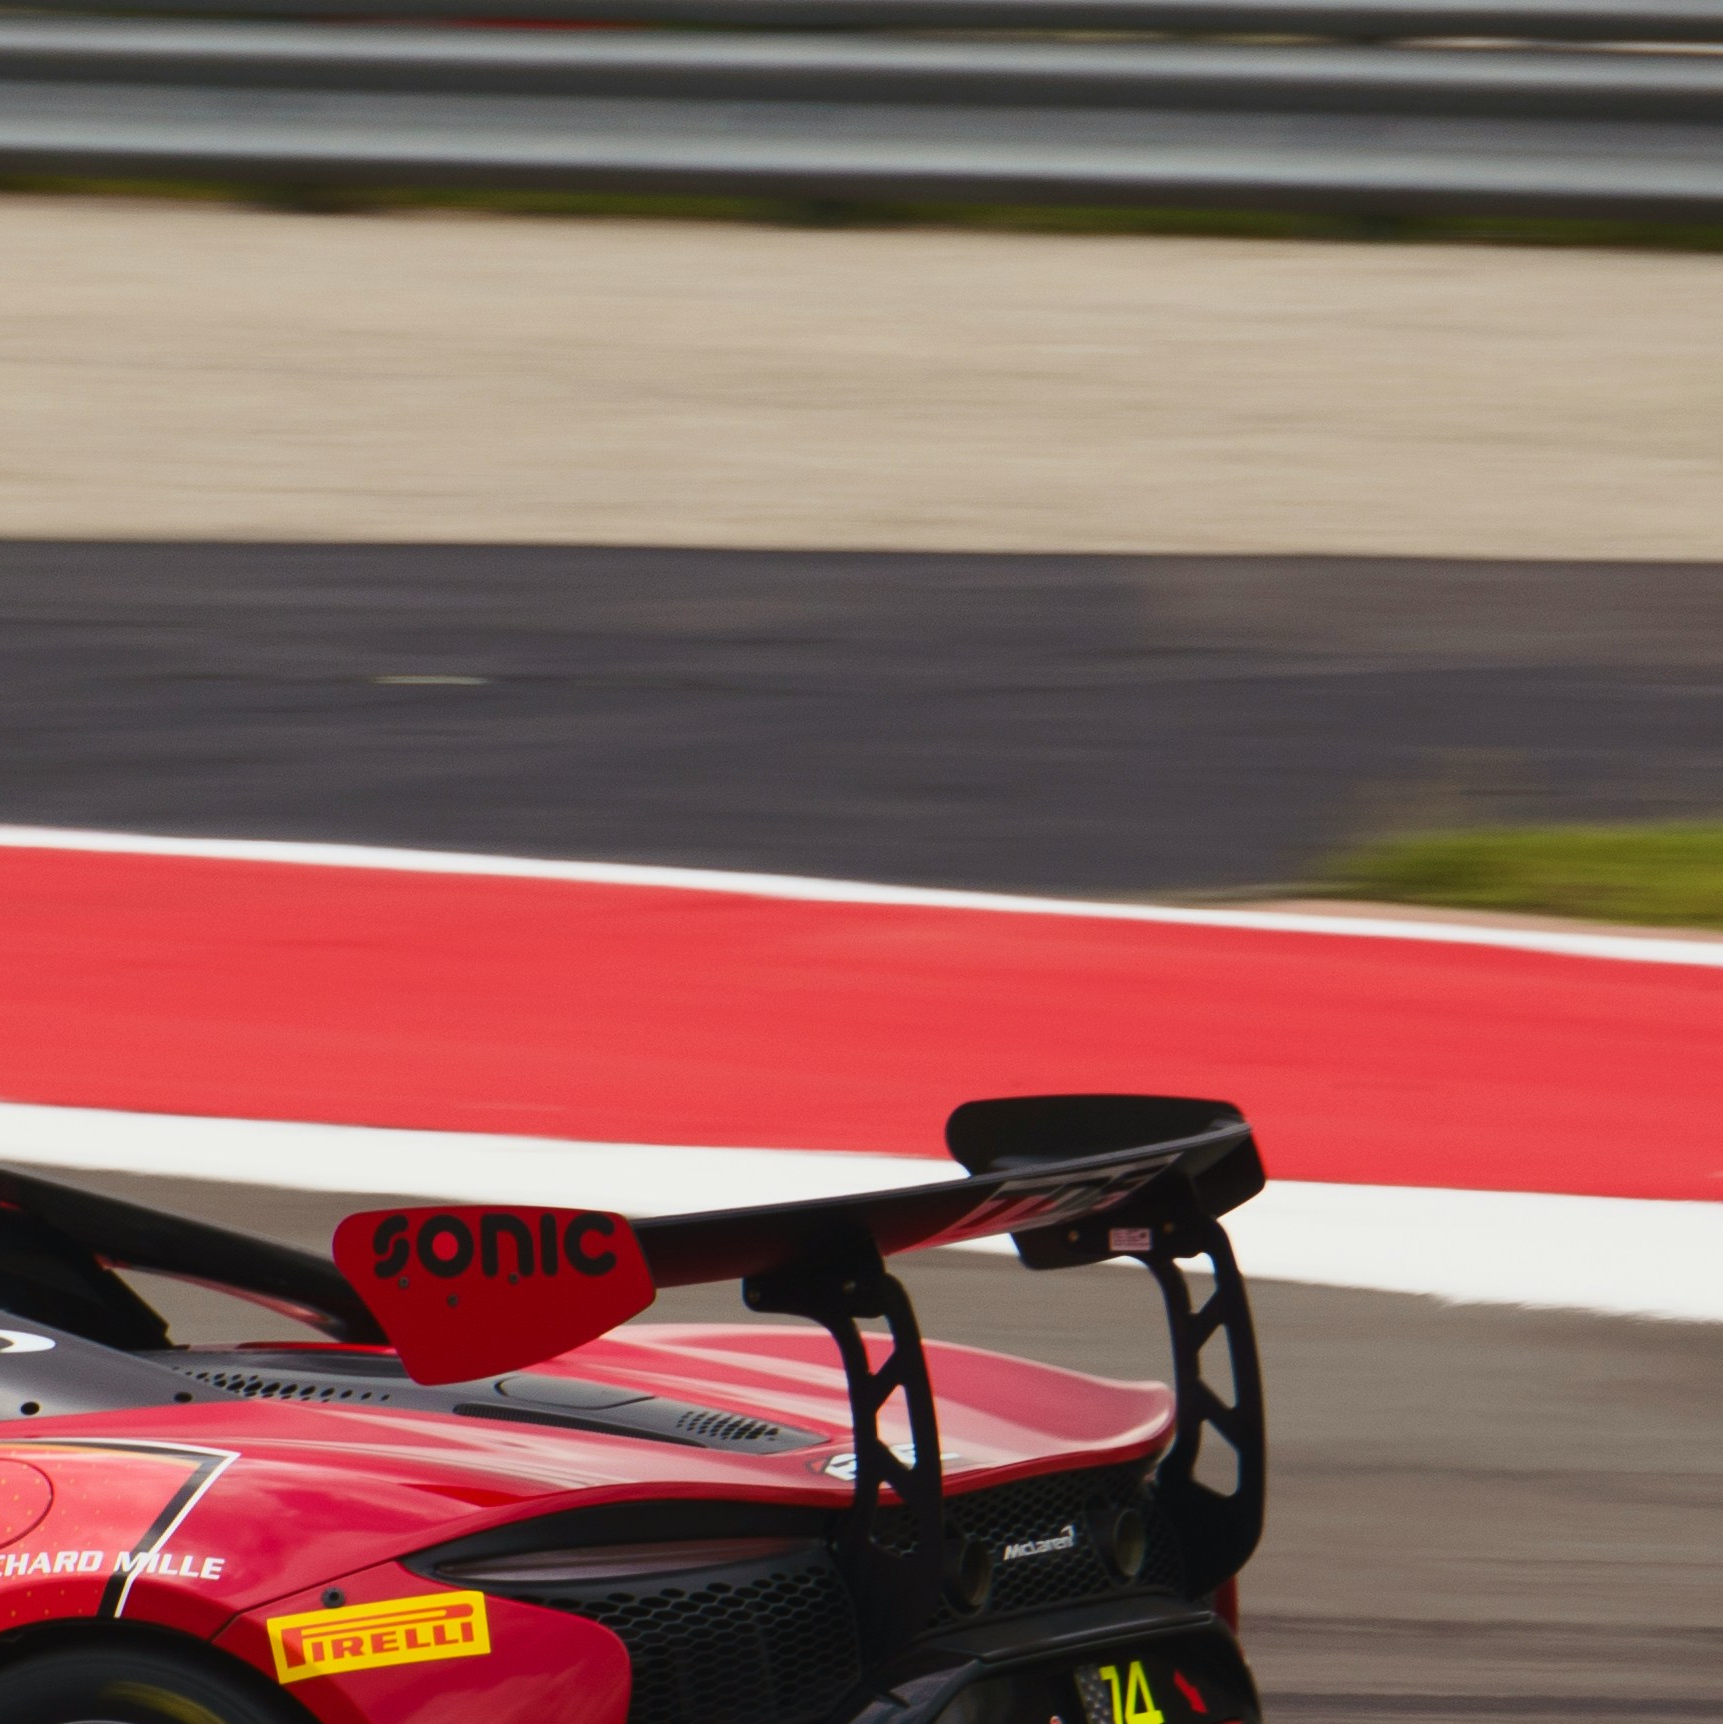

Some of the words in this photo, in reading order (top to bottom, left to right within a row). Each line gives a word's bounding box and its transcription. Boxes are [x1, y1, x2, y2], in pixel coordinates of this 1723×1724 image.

[372, 1210, 618, 1279] SONIC
[112, 1550, 226, 1581] MILLE
[281, 1602, 475, 1669] PIRELLI
